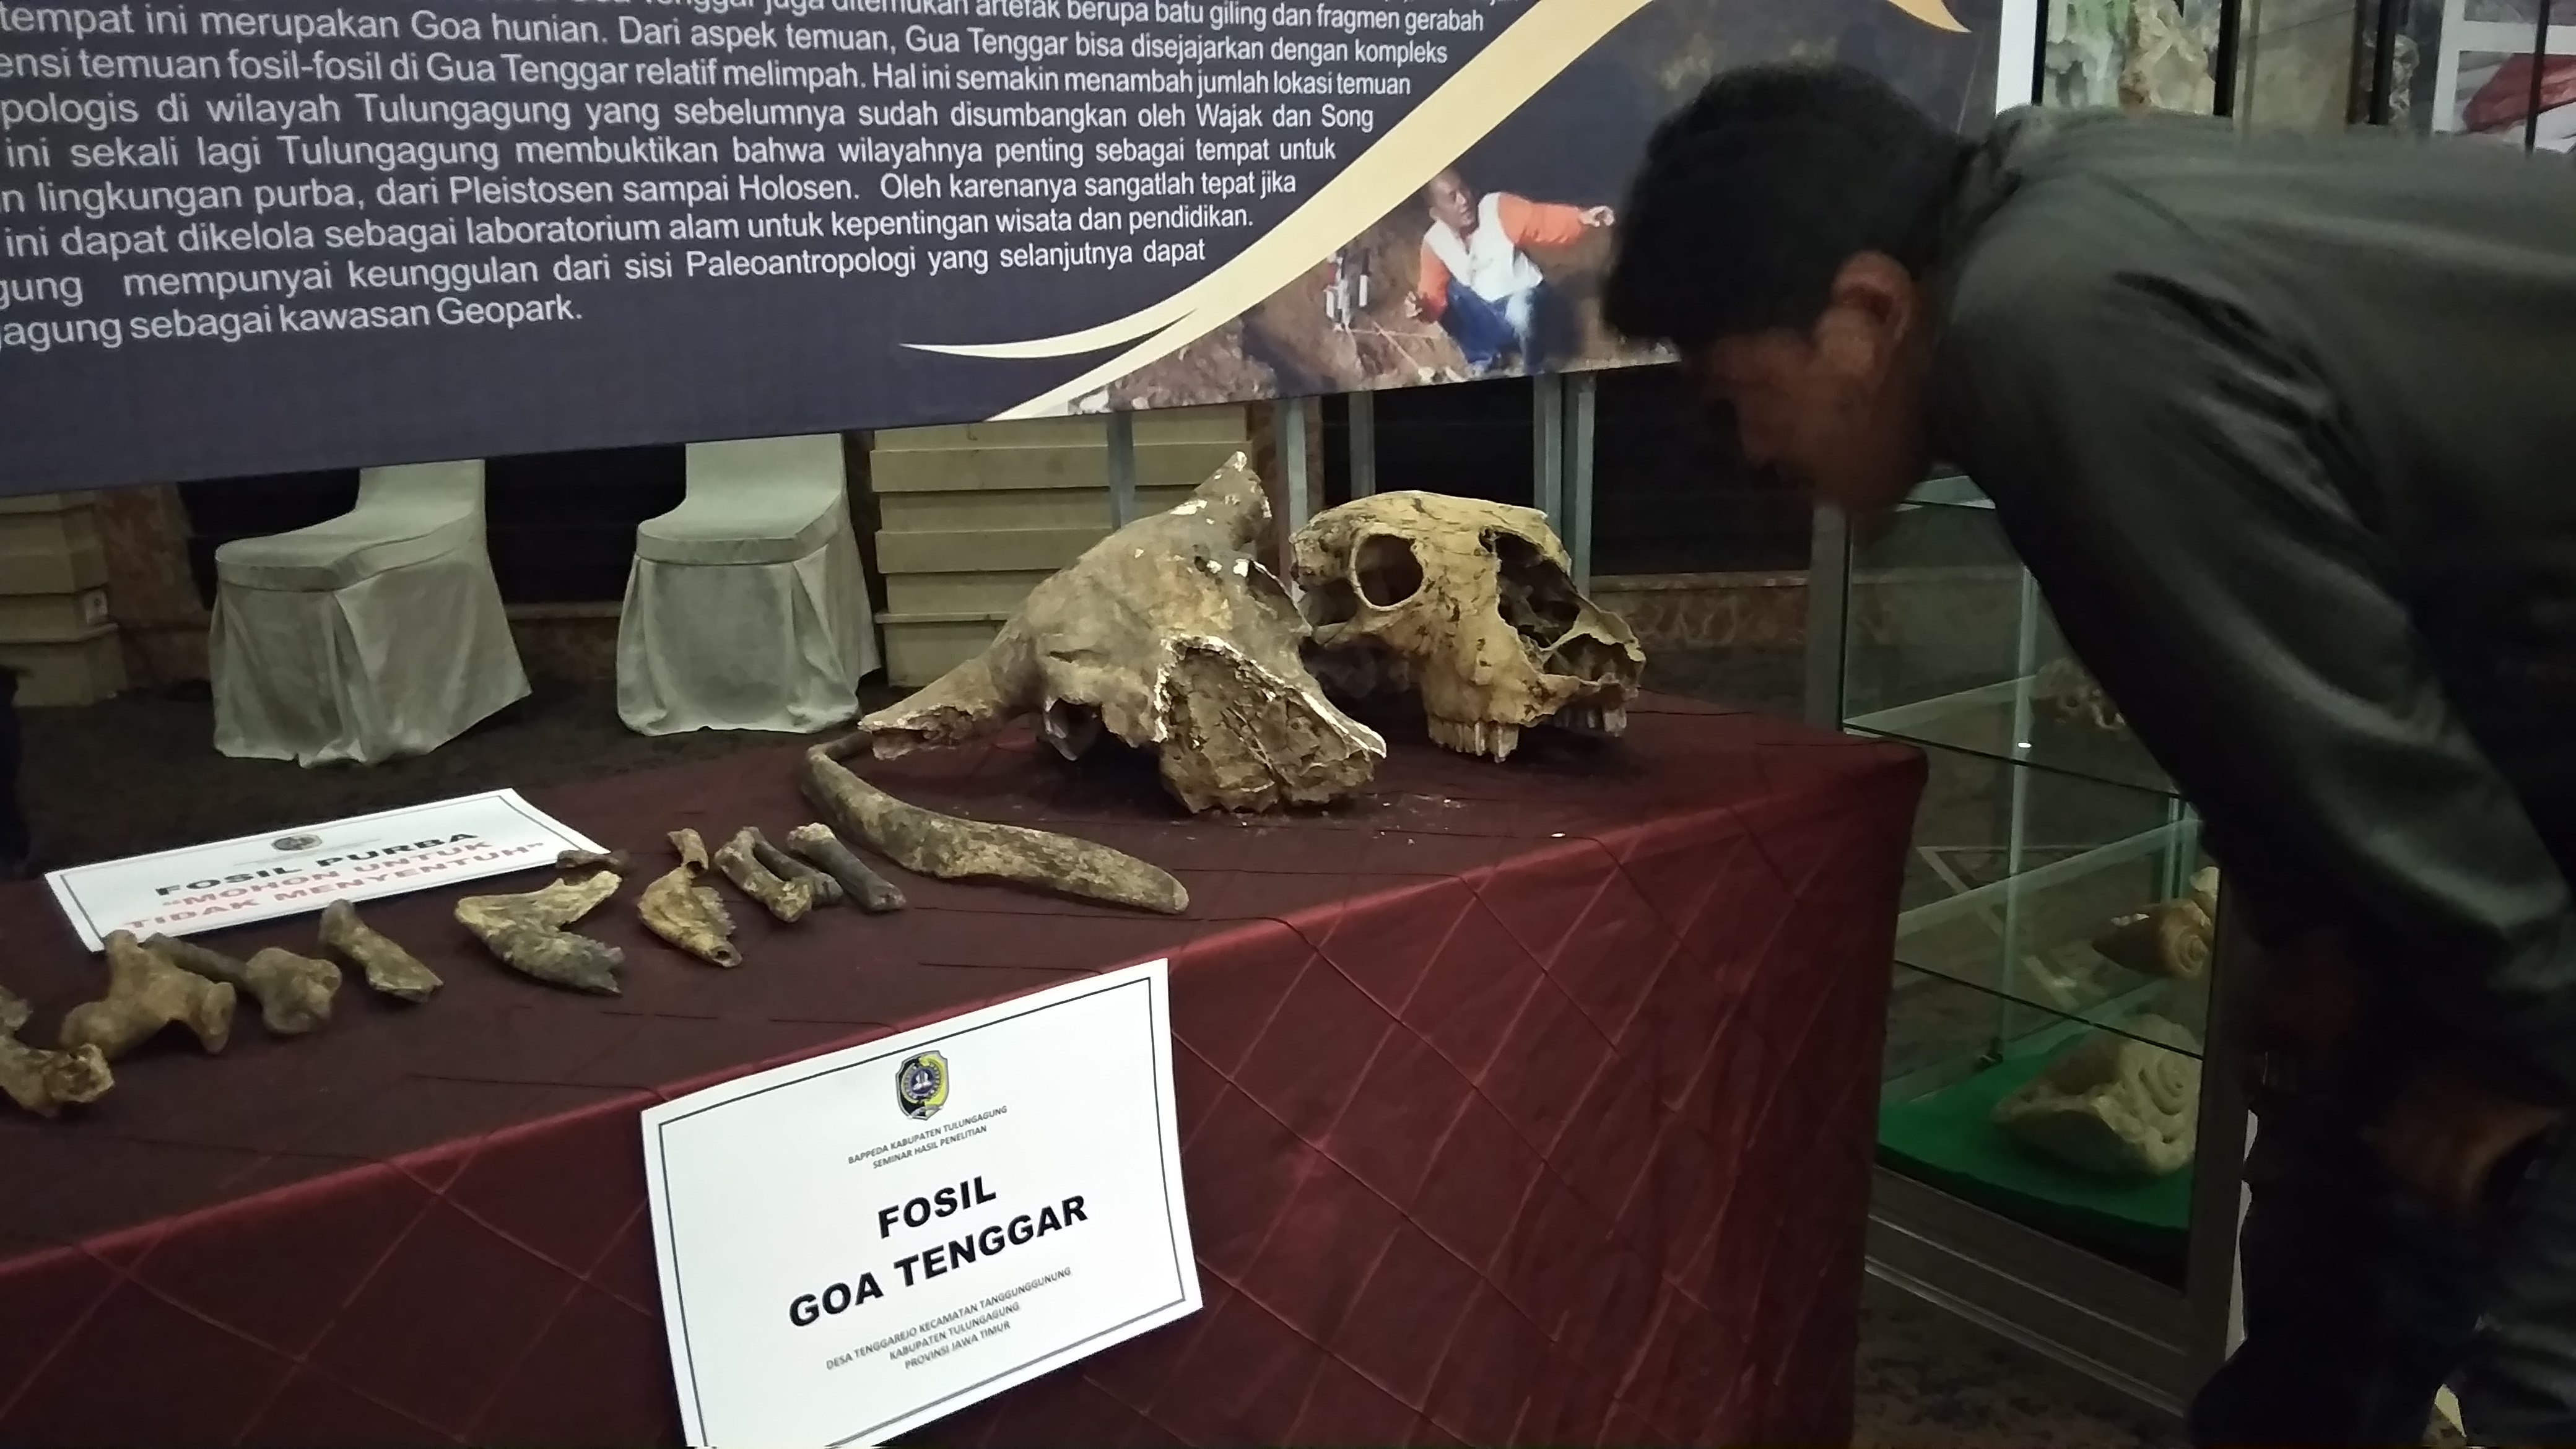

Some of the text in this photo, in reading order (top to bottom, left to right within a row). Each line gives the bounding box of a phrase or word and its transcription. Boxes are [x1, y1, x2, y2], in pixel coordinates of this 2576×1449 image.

[0, 1, 1448, 69] tempat ini merupakan Goa hunian. Dari aspek temuan, Gua Tenggar bisa disejajarkan dengan kompleks
[975, 0, 1061, 19] artefak
[1067, 0, 1149, 28] berupa
[1155, 0, 1204, 24] batu
[1209, 0, 1267, 32] giling
[1271, 1, 1312, 27] dan
[1316, 2, 1400, 35] fragmen
[1404, 7, 1484, 36] gerabah
[0, 47, 1411, 100] ensi temuan fosil-fosil di Gua Tenggar relatif melimpah. Hal ini semakin menambah jumlah lokasi temuan
[1, 92, 1374, 134] pologis di wilayah Tulungagung yang sebelumnya sudah disumbangkan oleh Wajak dan Song
[6, 135, 1336, 173] ini sekali lagi Tulungagung membuktikan bahwa wilayahnya penting sebagai tempat untuk
[0, 169, 1296, 219] n lingkungan purba, dari Pleistosen sampai Holosen. Oleh karenanya sangatlah tepat jika
[5, 204, 1253, 262] ini dapat dikelola sebagai laboratorium alam untuk kepentingan wisata dan pendidikan.
[123, 261, 332, 300] mempunyai
[347, 256, 539, 293] keunggulan
[552, 253, 611, 282] dari
[624, 251, 672, 279] sisi
[685, 245, 916, 279] Paleoantropologi
[927, 249, 989, 277] yang
[999, 241, 1133, 272] selanjutnya
[1142, 238, 1206, 268] dapat
[0, 292, 583, 352] agung sebagai kawasan Geopark.
[155, 867, 303, 896] FOSIL
[316, 833, 479, 867] PURBA
[353, 841, 493, 872] UNTUK
[124, 899, 259, 928] TIDAK
[848, 1105, 1007, 1164] BAPPEDA KABUPATEN TULUNGAGUNG
[872, 1125, 987, 1169] SEMINAR HASIL PENELITIAN
[877, 1176, 997, 1239] FOSIL
[788, 1194, 1089, 1328] GOA TENGGAR
[826, 1266, 1071, 1370] DESA TENGGAREJO KECAMATAN TANGGUNGGUNUNG
[889, 1302, 1020, 1360] KABUPATEN TULUNGAGUNG
[904, 1320, 1011, 1370] PROVINSI JAWA TIMUR
